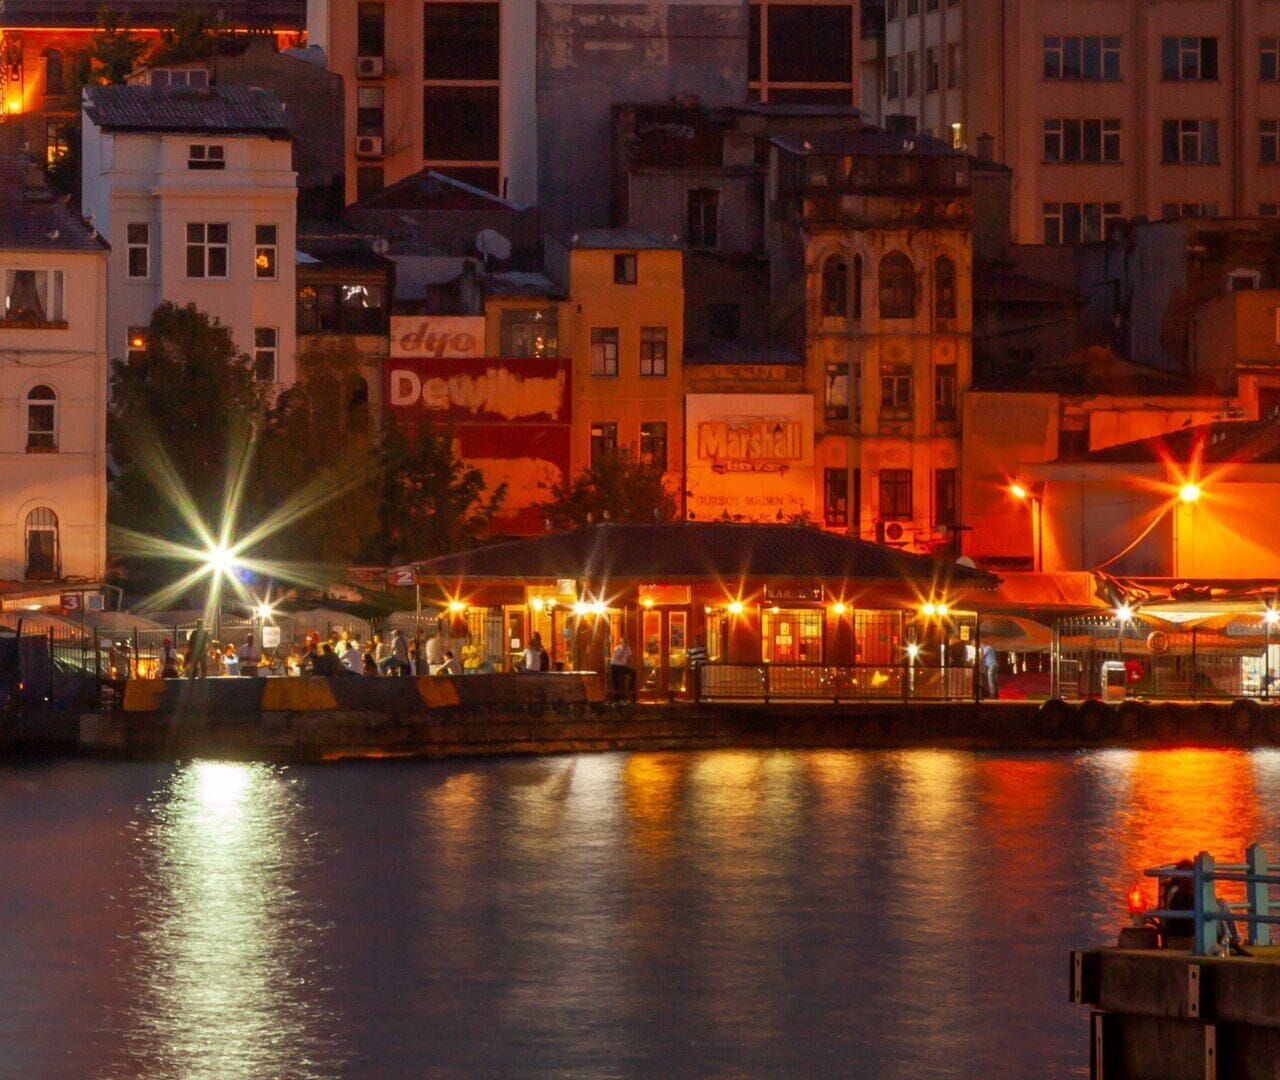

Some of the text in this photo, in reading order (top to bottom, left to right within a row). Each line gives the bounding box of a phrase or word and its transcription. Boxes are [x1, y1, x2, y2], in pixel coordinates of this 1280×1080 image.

[702, 424, 800, 458] Marshall
[397, 571, 413, 583] 2
[63, 596, 79, 609] 3
